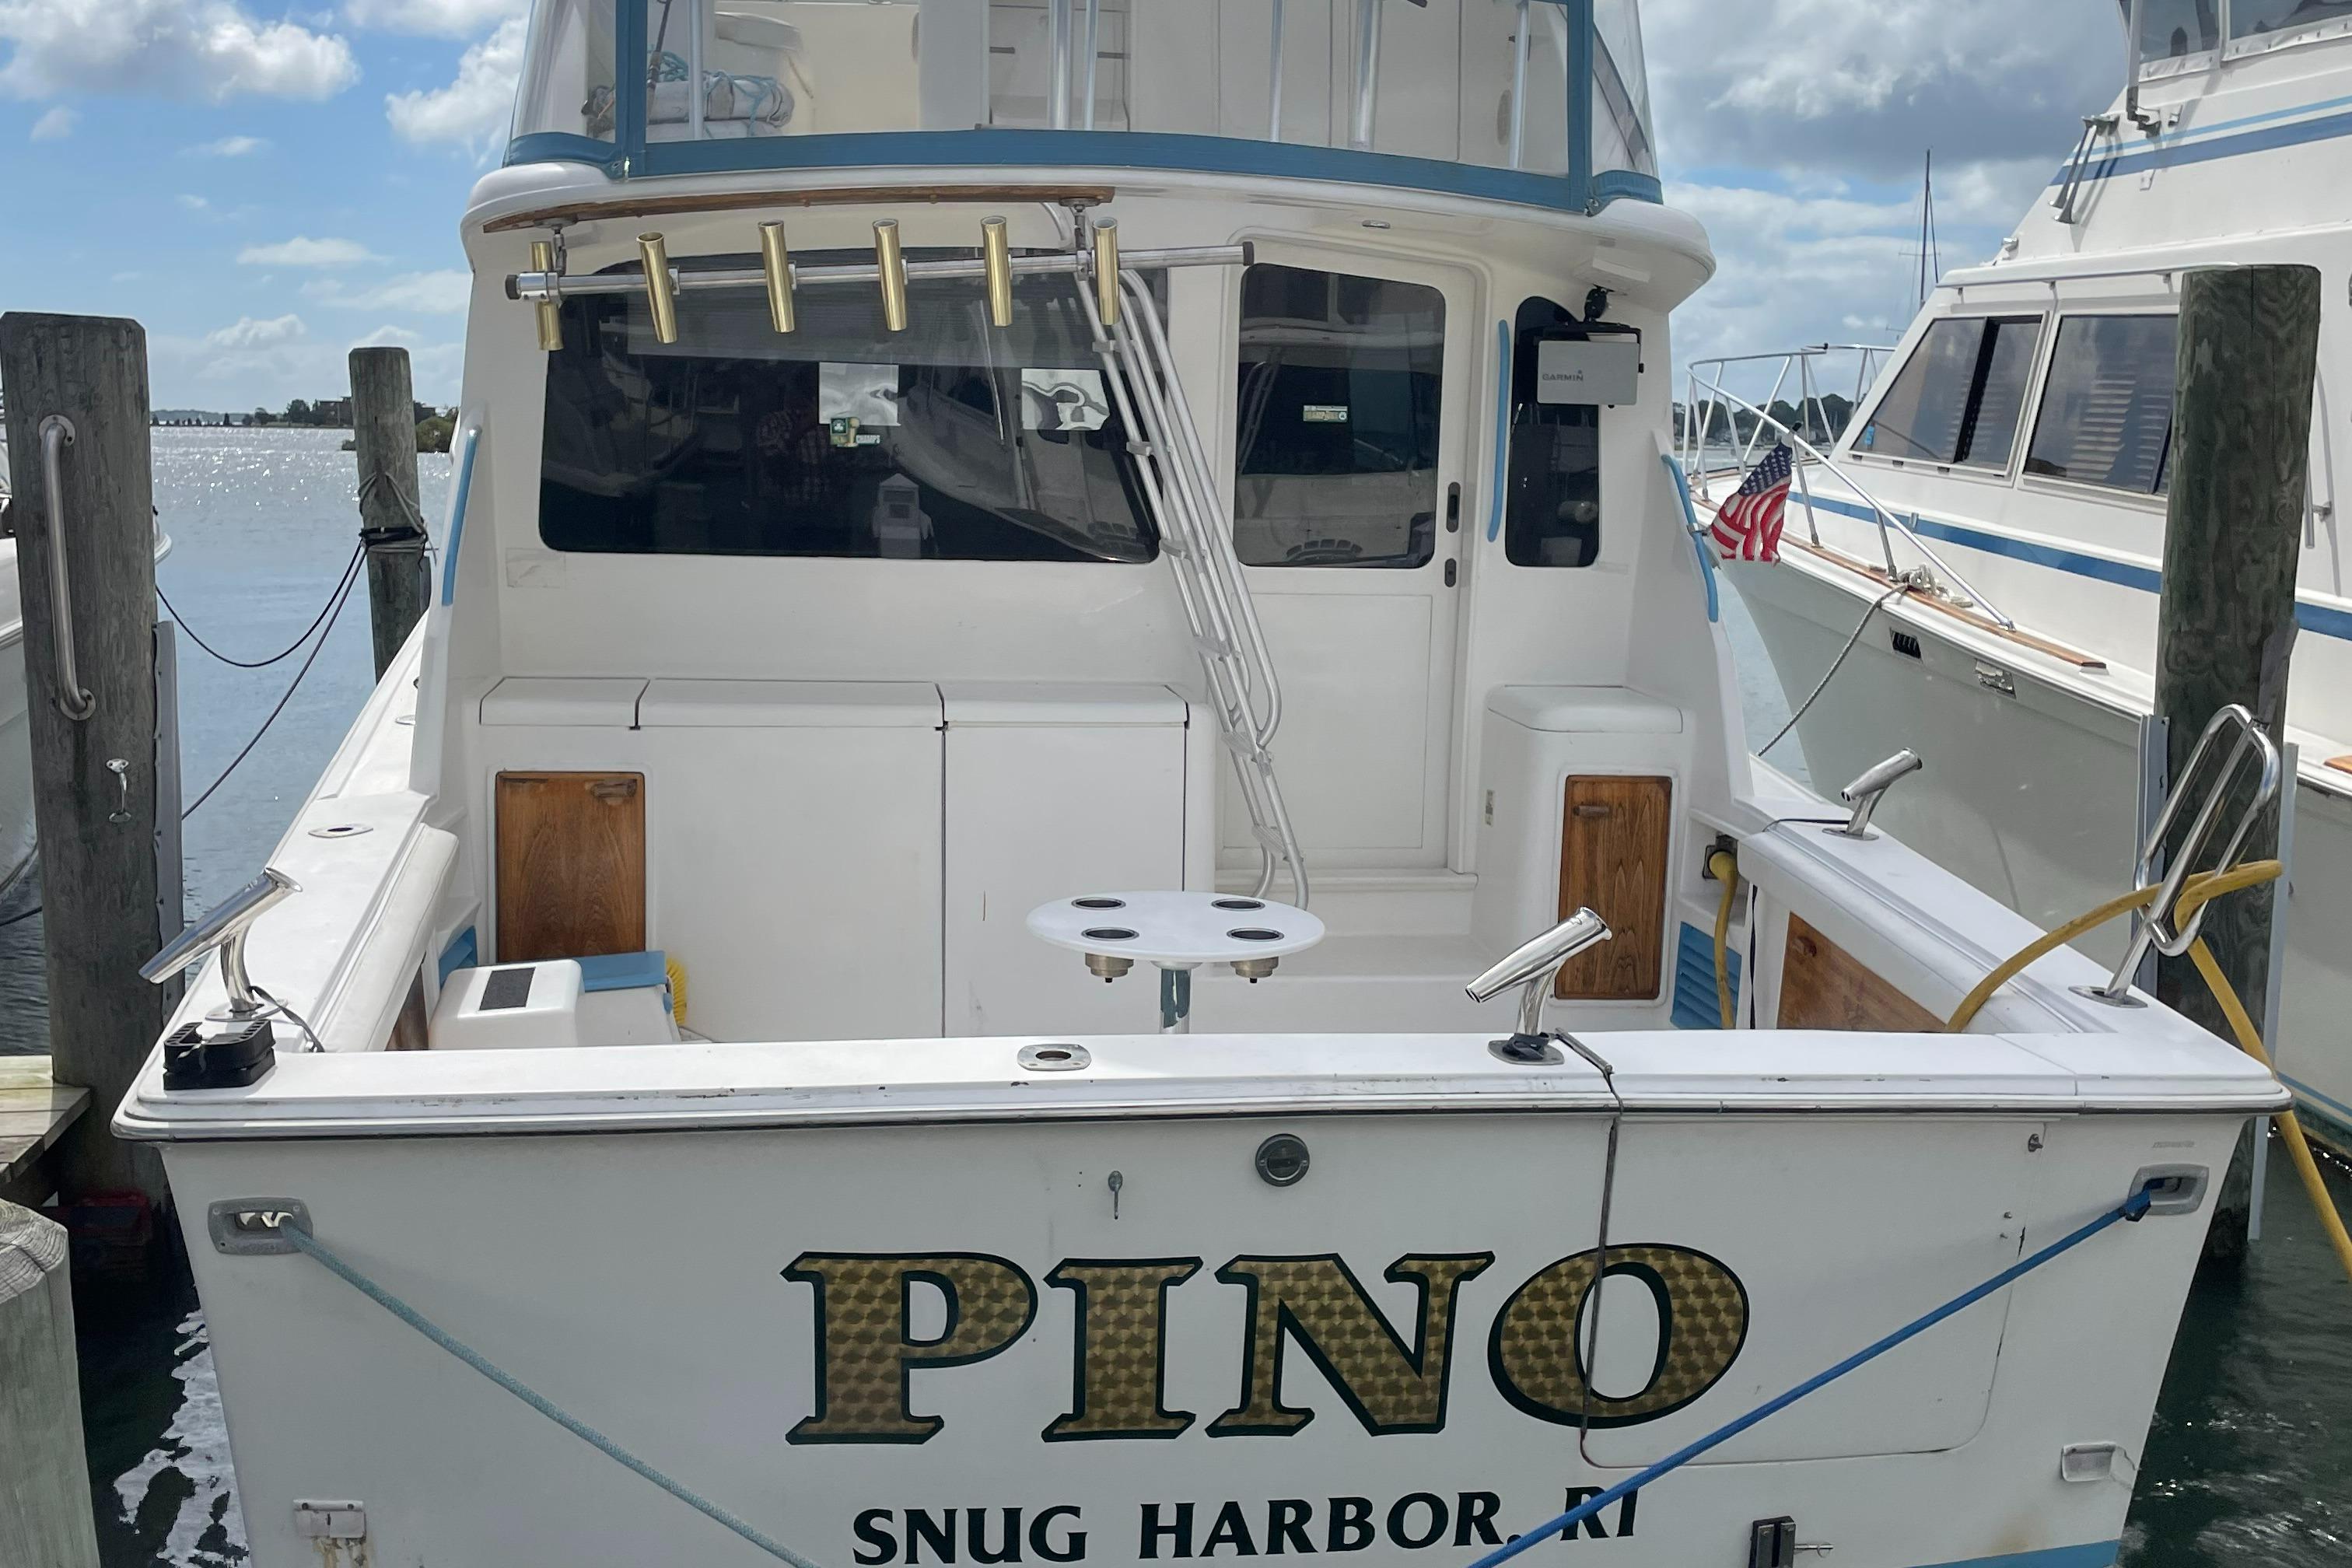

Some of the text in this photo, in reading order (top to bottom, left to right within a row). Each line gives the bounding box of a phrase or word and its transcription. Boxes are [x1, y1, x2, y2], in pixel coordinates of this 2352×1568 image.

[1542, 373, 1584, 382] GARMIN
[780, 1242, 1750, 1446] PINO
[852, 1504, 1088, 1566] SNUG
[1559, 1485, 1640, 1541] RI
